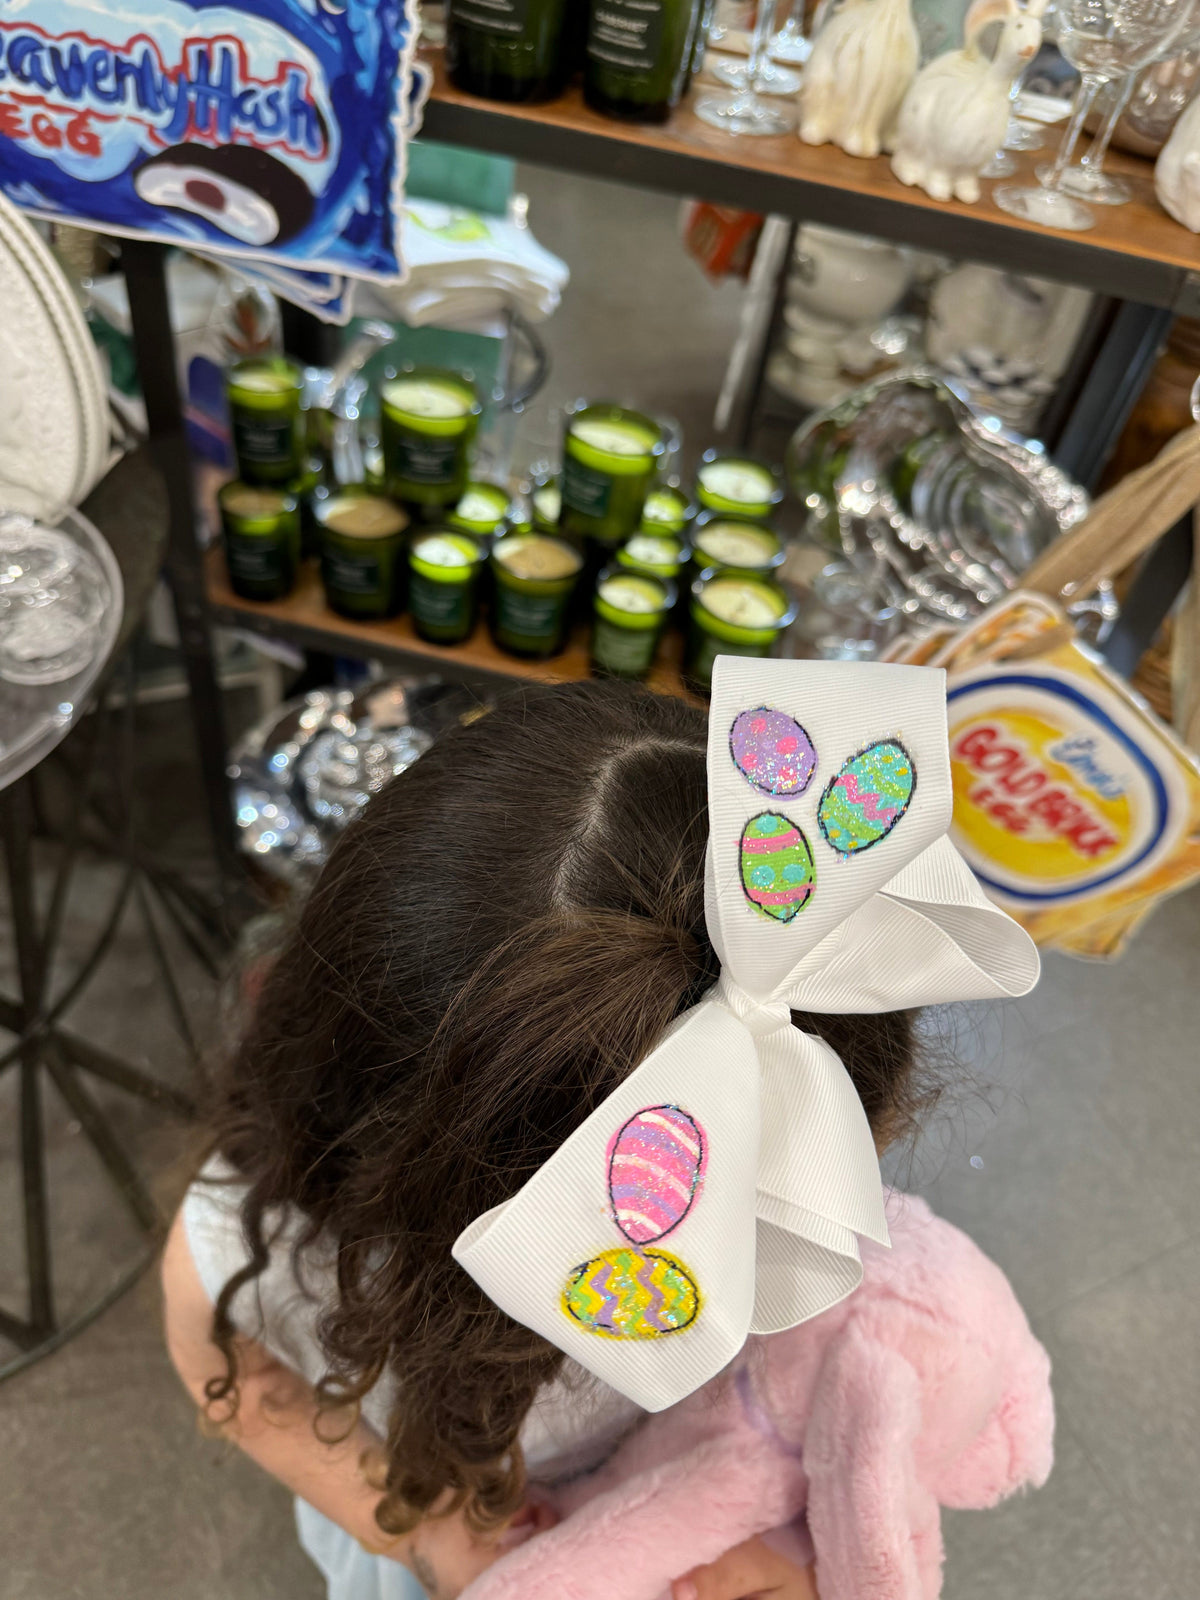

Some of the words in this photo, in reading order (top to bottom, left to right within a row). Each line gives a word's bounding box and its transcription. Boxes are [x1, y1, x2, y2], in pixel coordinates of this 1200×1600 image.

[0, 32, 188, 141] avenly
[189, 46, 319, 154] Hash
[0, 102, 103, 158] EGG
[956, 728, 1047, 796] GOLD
